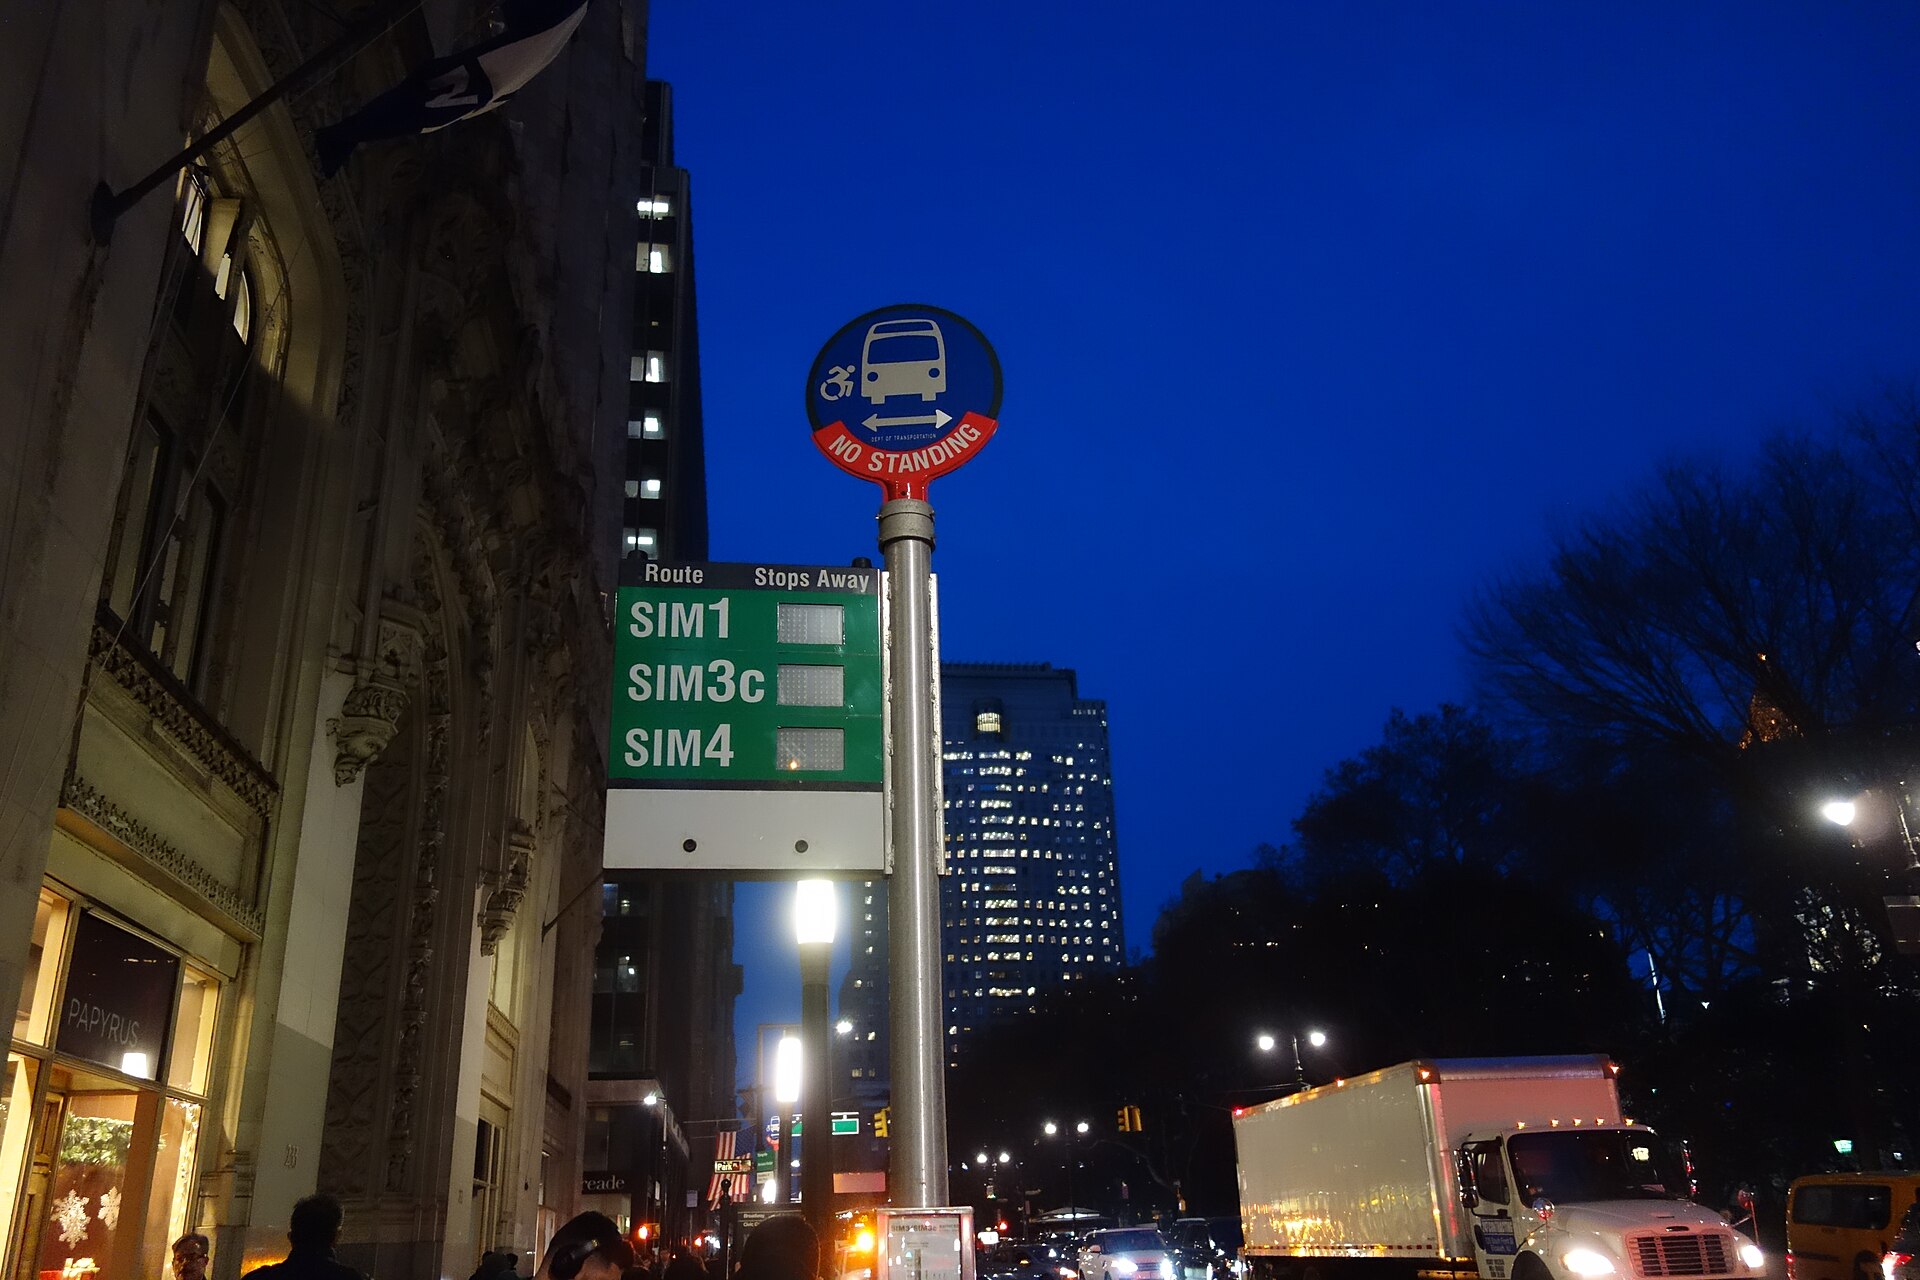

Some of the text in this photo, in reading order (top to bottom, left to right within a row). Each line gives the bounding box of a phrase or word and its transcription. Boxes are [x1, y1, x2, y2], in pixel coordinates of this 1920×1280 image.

[828, 423, 982, 474] NO STANDING
[893, 433, 936, 441] TRANSPORTATION
[645, 563, 870, 592] Route Stops Away
[629, 597, 730, 639] SIM1
[627, 659, 765, 704] SIM3c
[623, 723, 735, 768] SIM4
[68, 997, 140, 1047] PAPYRUS
[717, 1163, 733, 1171] Park
